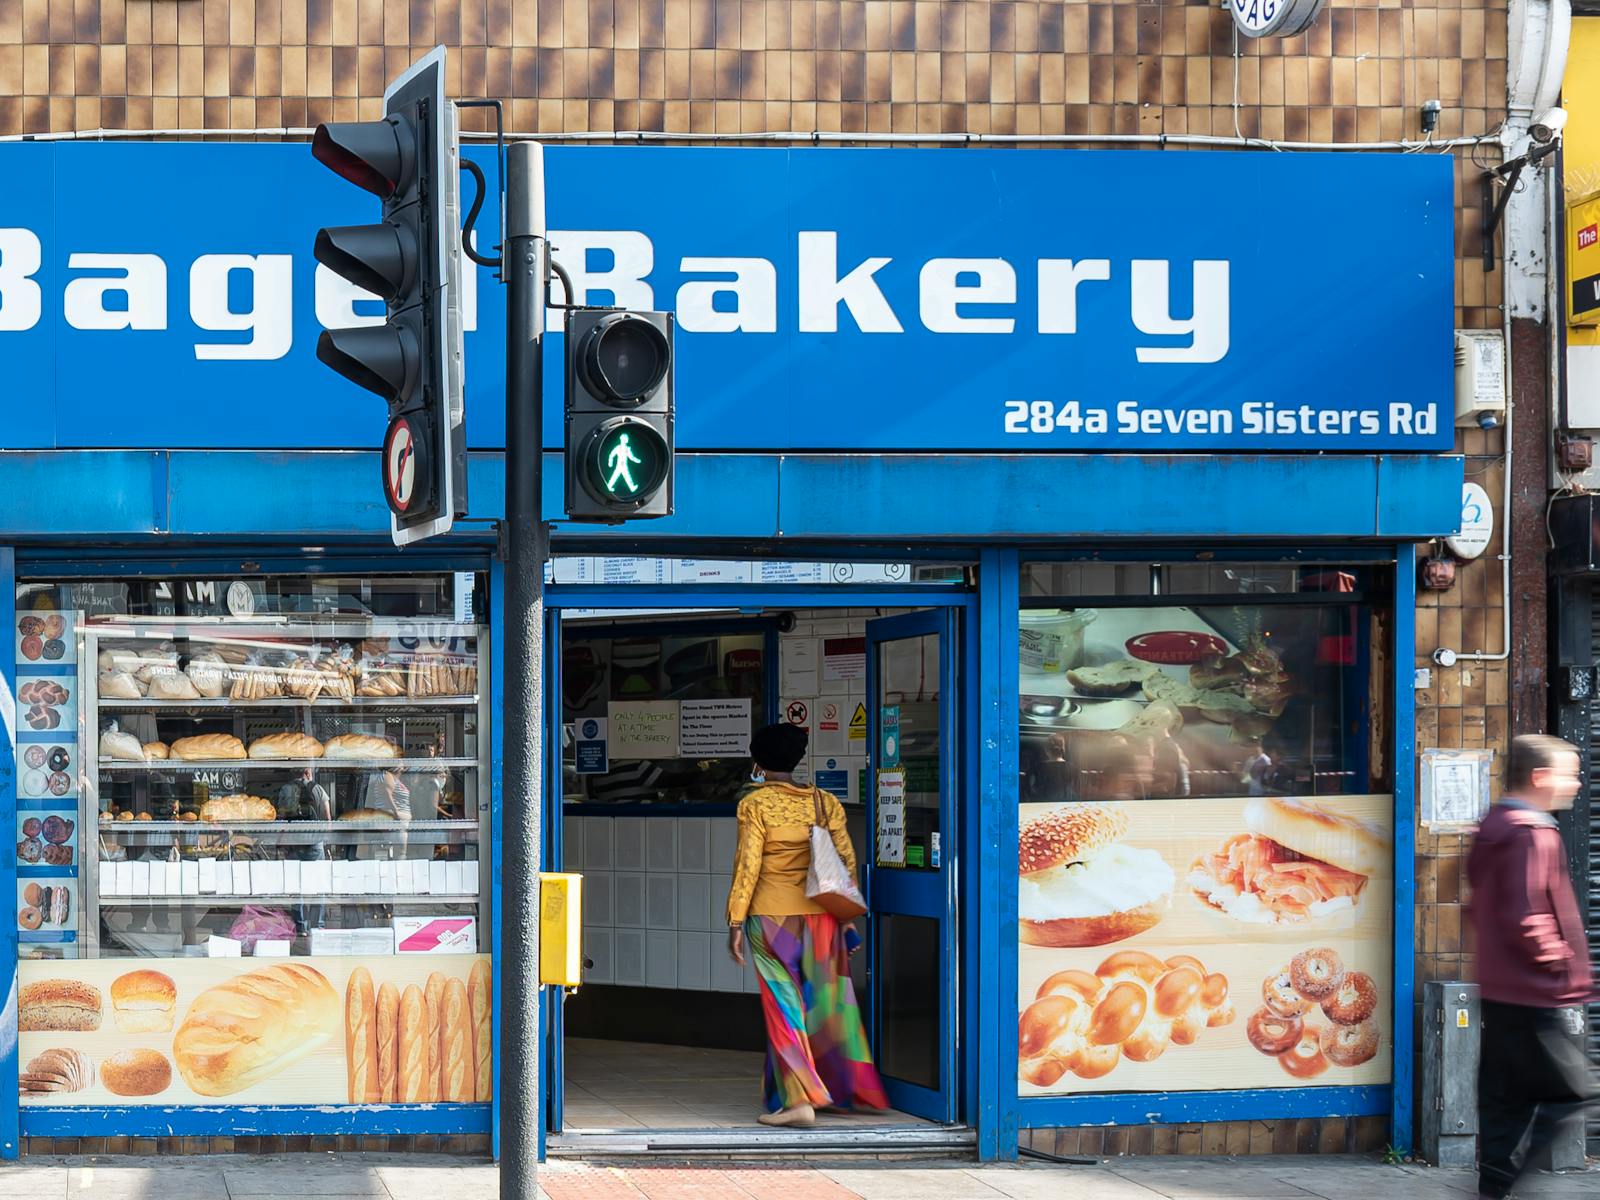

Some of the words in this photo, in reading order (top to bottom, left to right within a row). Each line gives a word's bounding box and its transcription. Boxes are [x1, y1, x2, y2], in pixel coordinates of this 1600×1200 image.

[1578, 229, 1597, 248] The
[546, 230, 1230, 363] Bakery
[1004, 401, 1108, 433] 284a
[1117, 402, 1233, 434] Seven
[1242, 402, 1379, 434] Sisters
[1389, 402, 1437, 435] Rd
[614, 711, 634, 721] ONLY
[617, 723, 626, 732] AT
[880, 796, 891, 805] KEEP
[891, 796, 902, 805] SAFE
[885, 814, 897, 823] KEEP
[888, 827, 903, 836] APART
